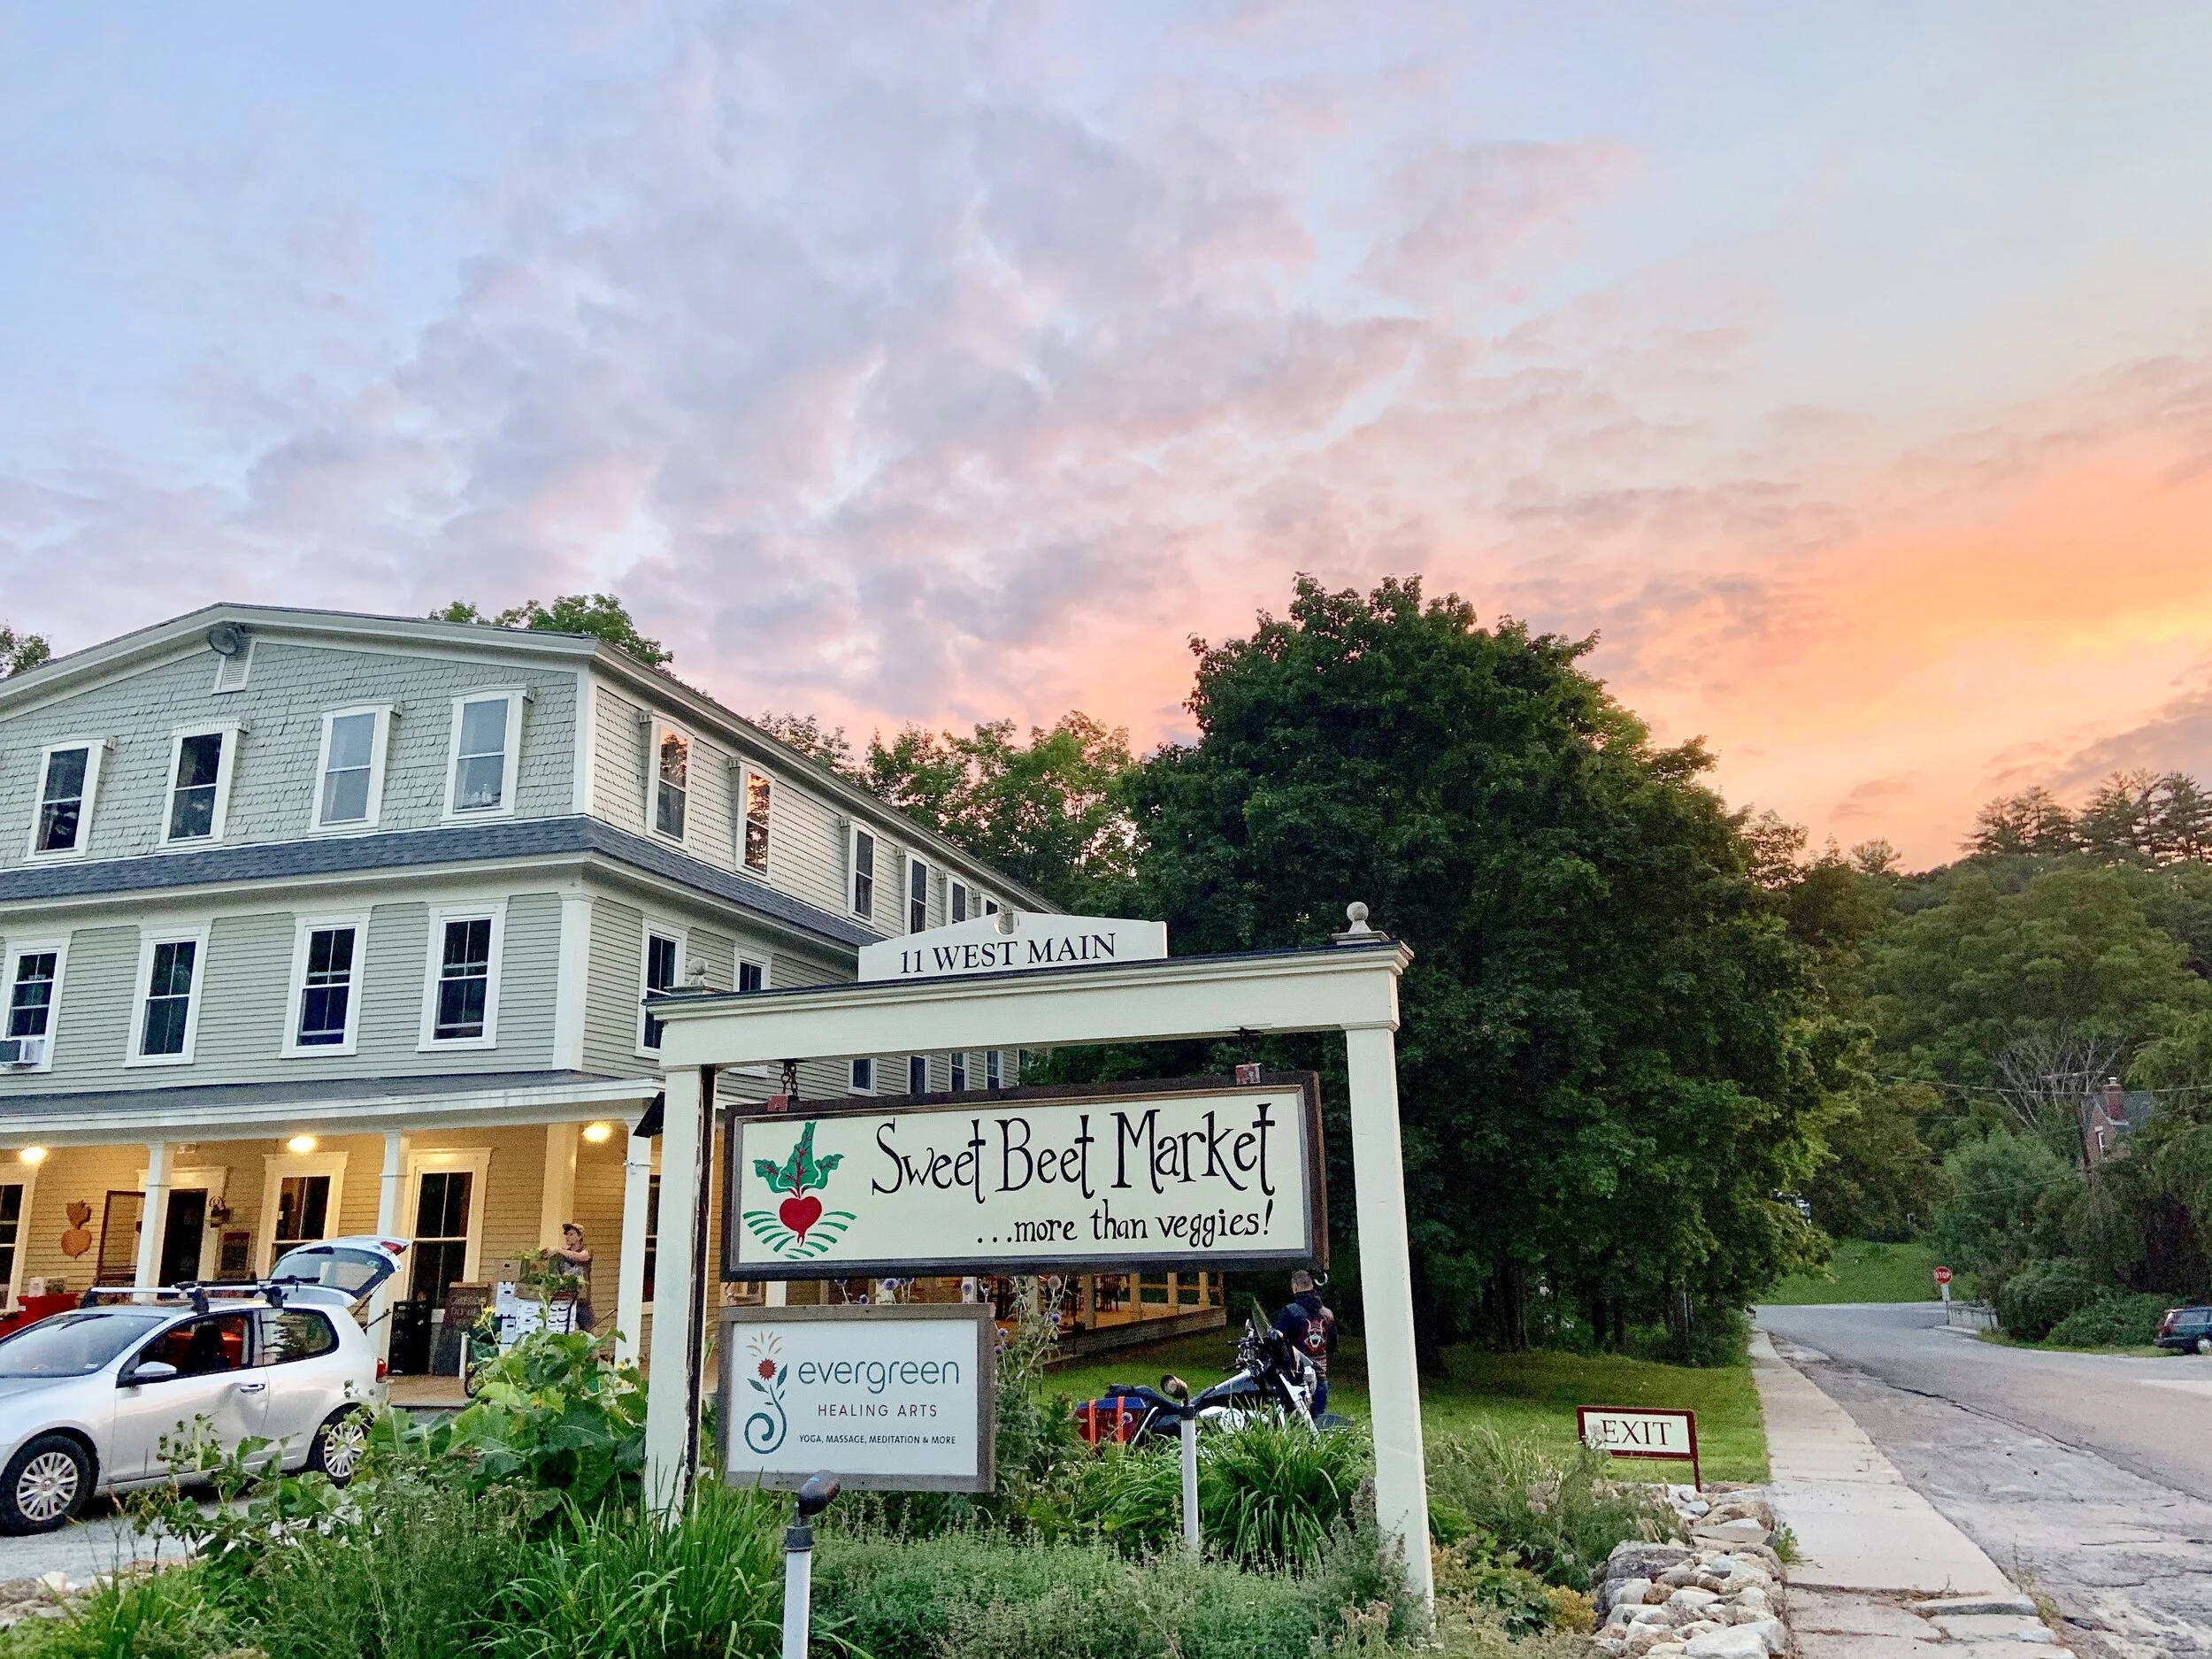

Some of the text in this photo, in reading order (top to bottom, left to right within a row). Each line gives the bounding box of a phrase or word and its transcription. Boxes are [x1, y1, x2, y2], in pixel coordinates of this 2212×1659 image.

[900, 933, 1117, 974] 11 WEST MAIN
[872, 1102, 1276, 1204] Sweet Beet Market
[1089, 1198, 1148, 1240] than
[1155, 1199, 1274, 1248] veggies!
[798, 1361, 960, 1394] evergreen
[818, 1404, 938, 1417] HEALING ARTS
[799, 1434, 824, 1444] YOGA,
[826, 1435, 867, 1445] MASSAGE,
[869, 1435, 920, 1444] MEDITATION
[1600, 1419, 1672, 1446] EXIT
